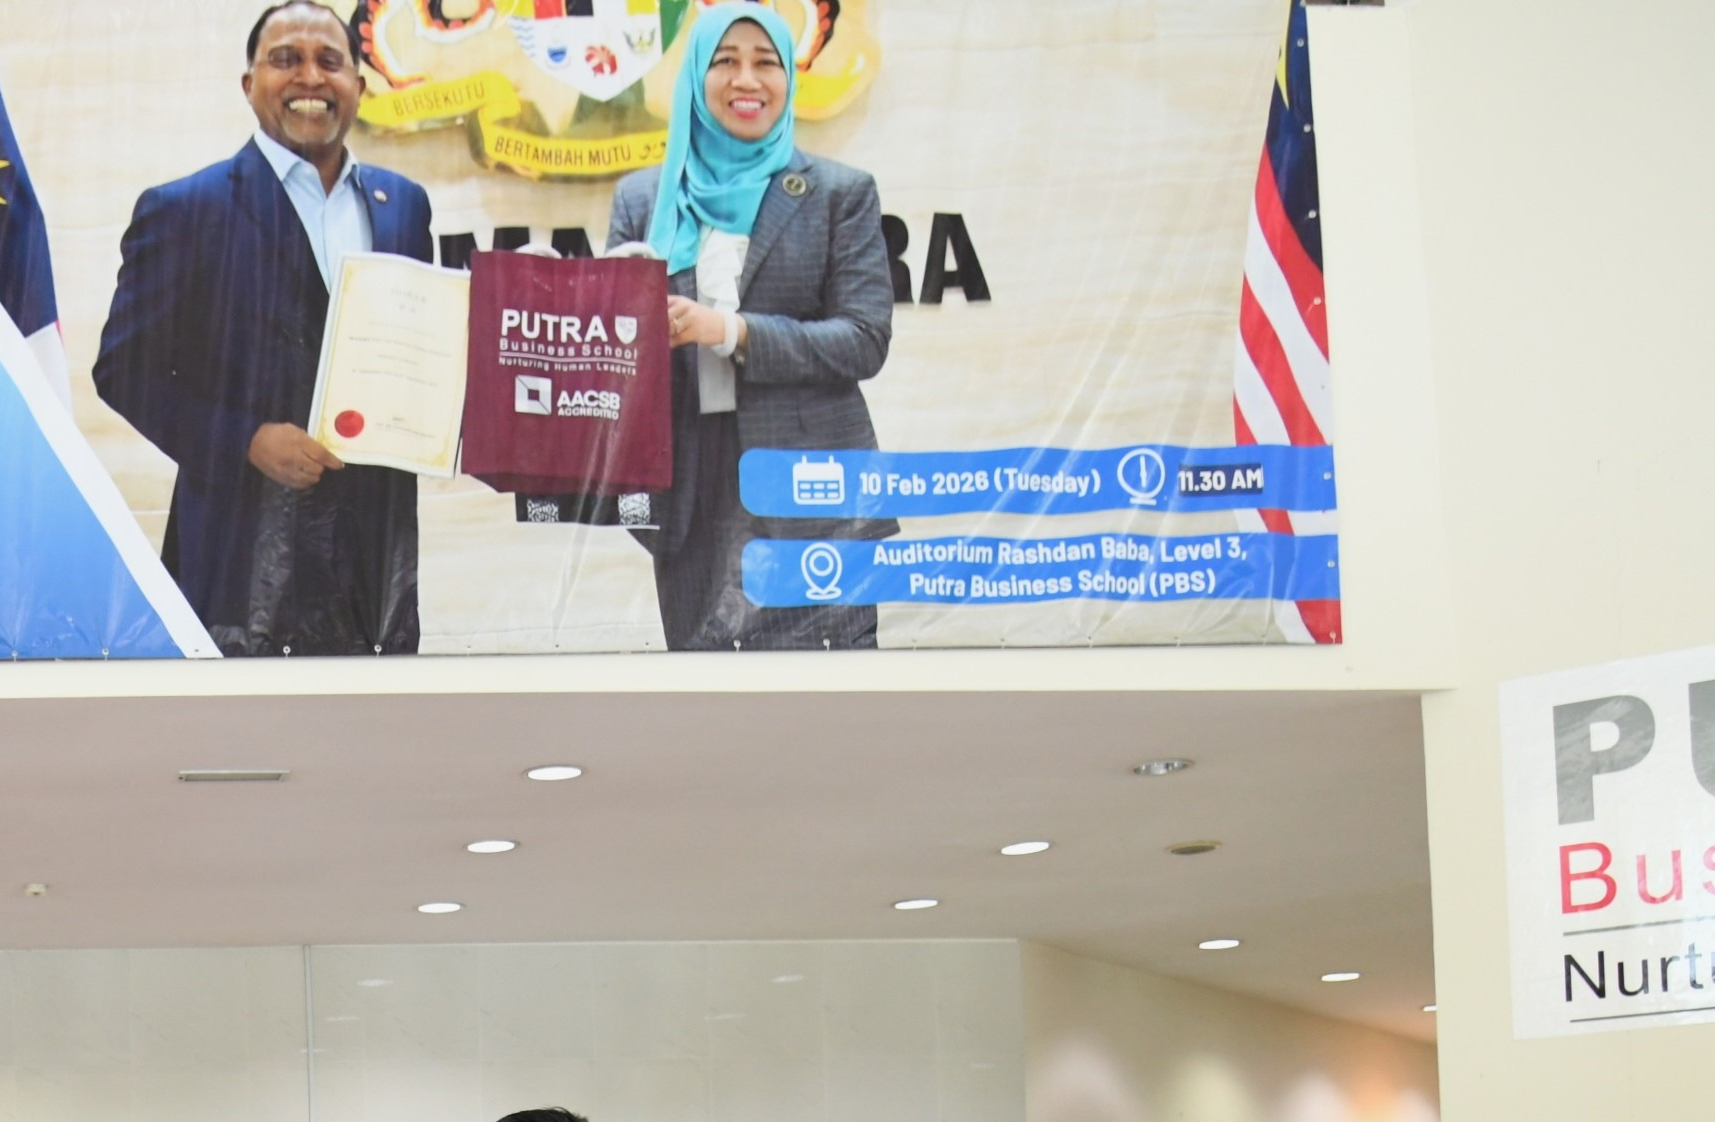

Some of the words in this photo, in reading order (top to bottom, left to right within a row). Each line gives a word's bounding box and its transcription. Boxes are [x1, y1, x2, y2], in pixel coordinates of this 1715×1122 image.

[393, 82, 485, 117] BERSEKUTU
[494, 135, 584, 166] BERTAMBAH
[588, 144, 632, 166] MUTU
[500, 308, 608, 344] PUTRA
[499, 337, 576, 357] Business
[582, 342, 638, 360] School
[498, 356, 550, 371] Nurturing
[554, 361, 591, 372] Human
[596, 362, 637, 376] Leaders
[556, 389, 620, 410] AACSB
[557, 406, 620, 421] ACCREDITED
[859, 471, 883, 496] 10
[886, 471, 927, 497] Feb
[931, 469, 990, 496] 2026
[995, 467, 1102, 499] (Tuesday)
[1178, 469, 1226, 494] 11.30
[1230, 468, 1264, 491] AM
[873, 539, 994, 568] Auditorium
[997, 538, 1096, 566] Rashdan
[1101, 535, 1154, 565] Baba,
[1159, 536, 1223, 564] Level
[1226, 540, 1248, 562] 3,
[909, 571, 967, 598] Putra
[969, 572, 1074, 600] Business
[1077, 569, 1146, 597] School
[1148, 566, 1217, 598] (PBS)
[1552, 679, 1715, 826] P
[1564, 942, 1715, 1003] Nurt
